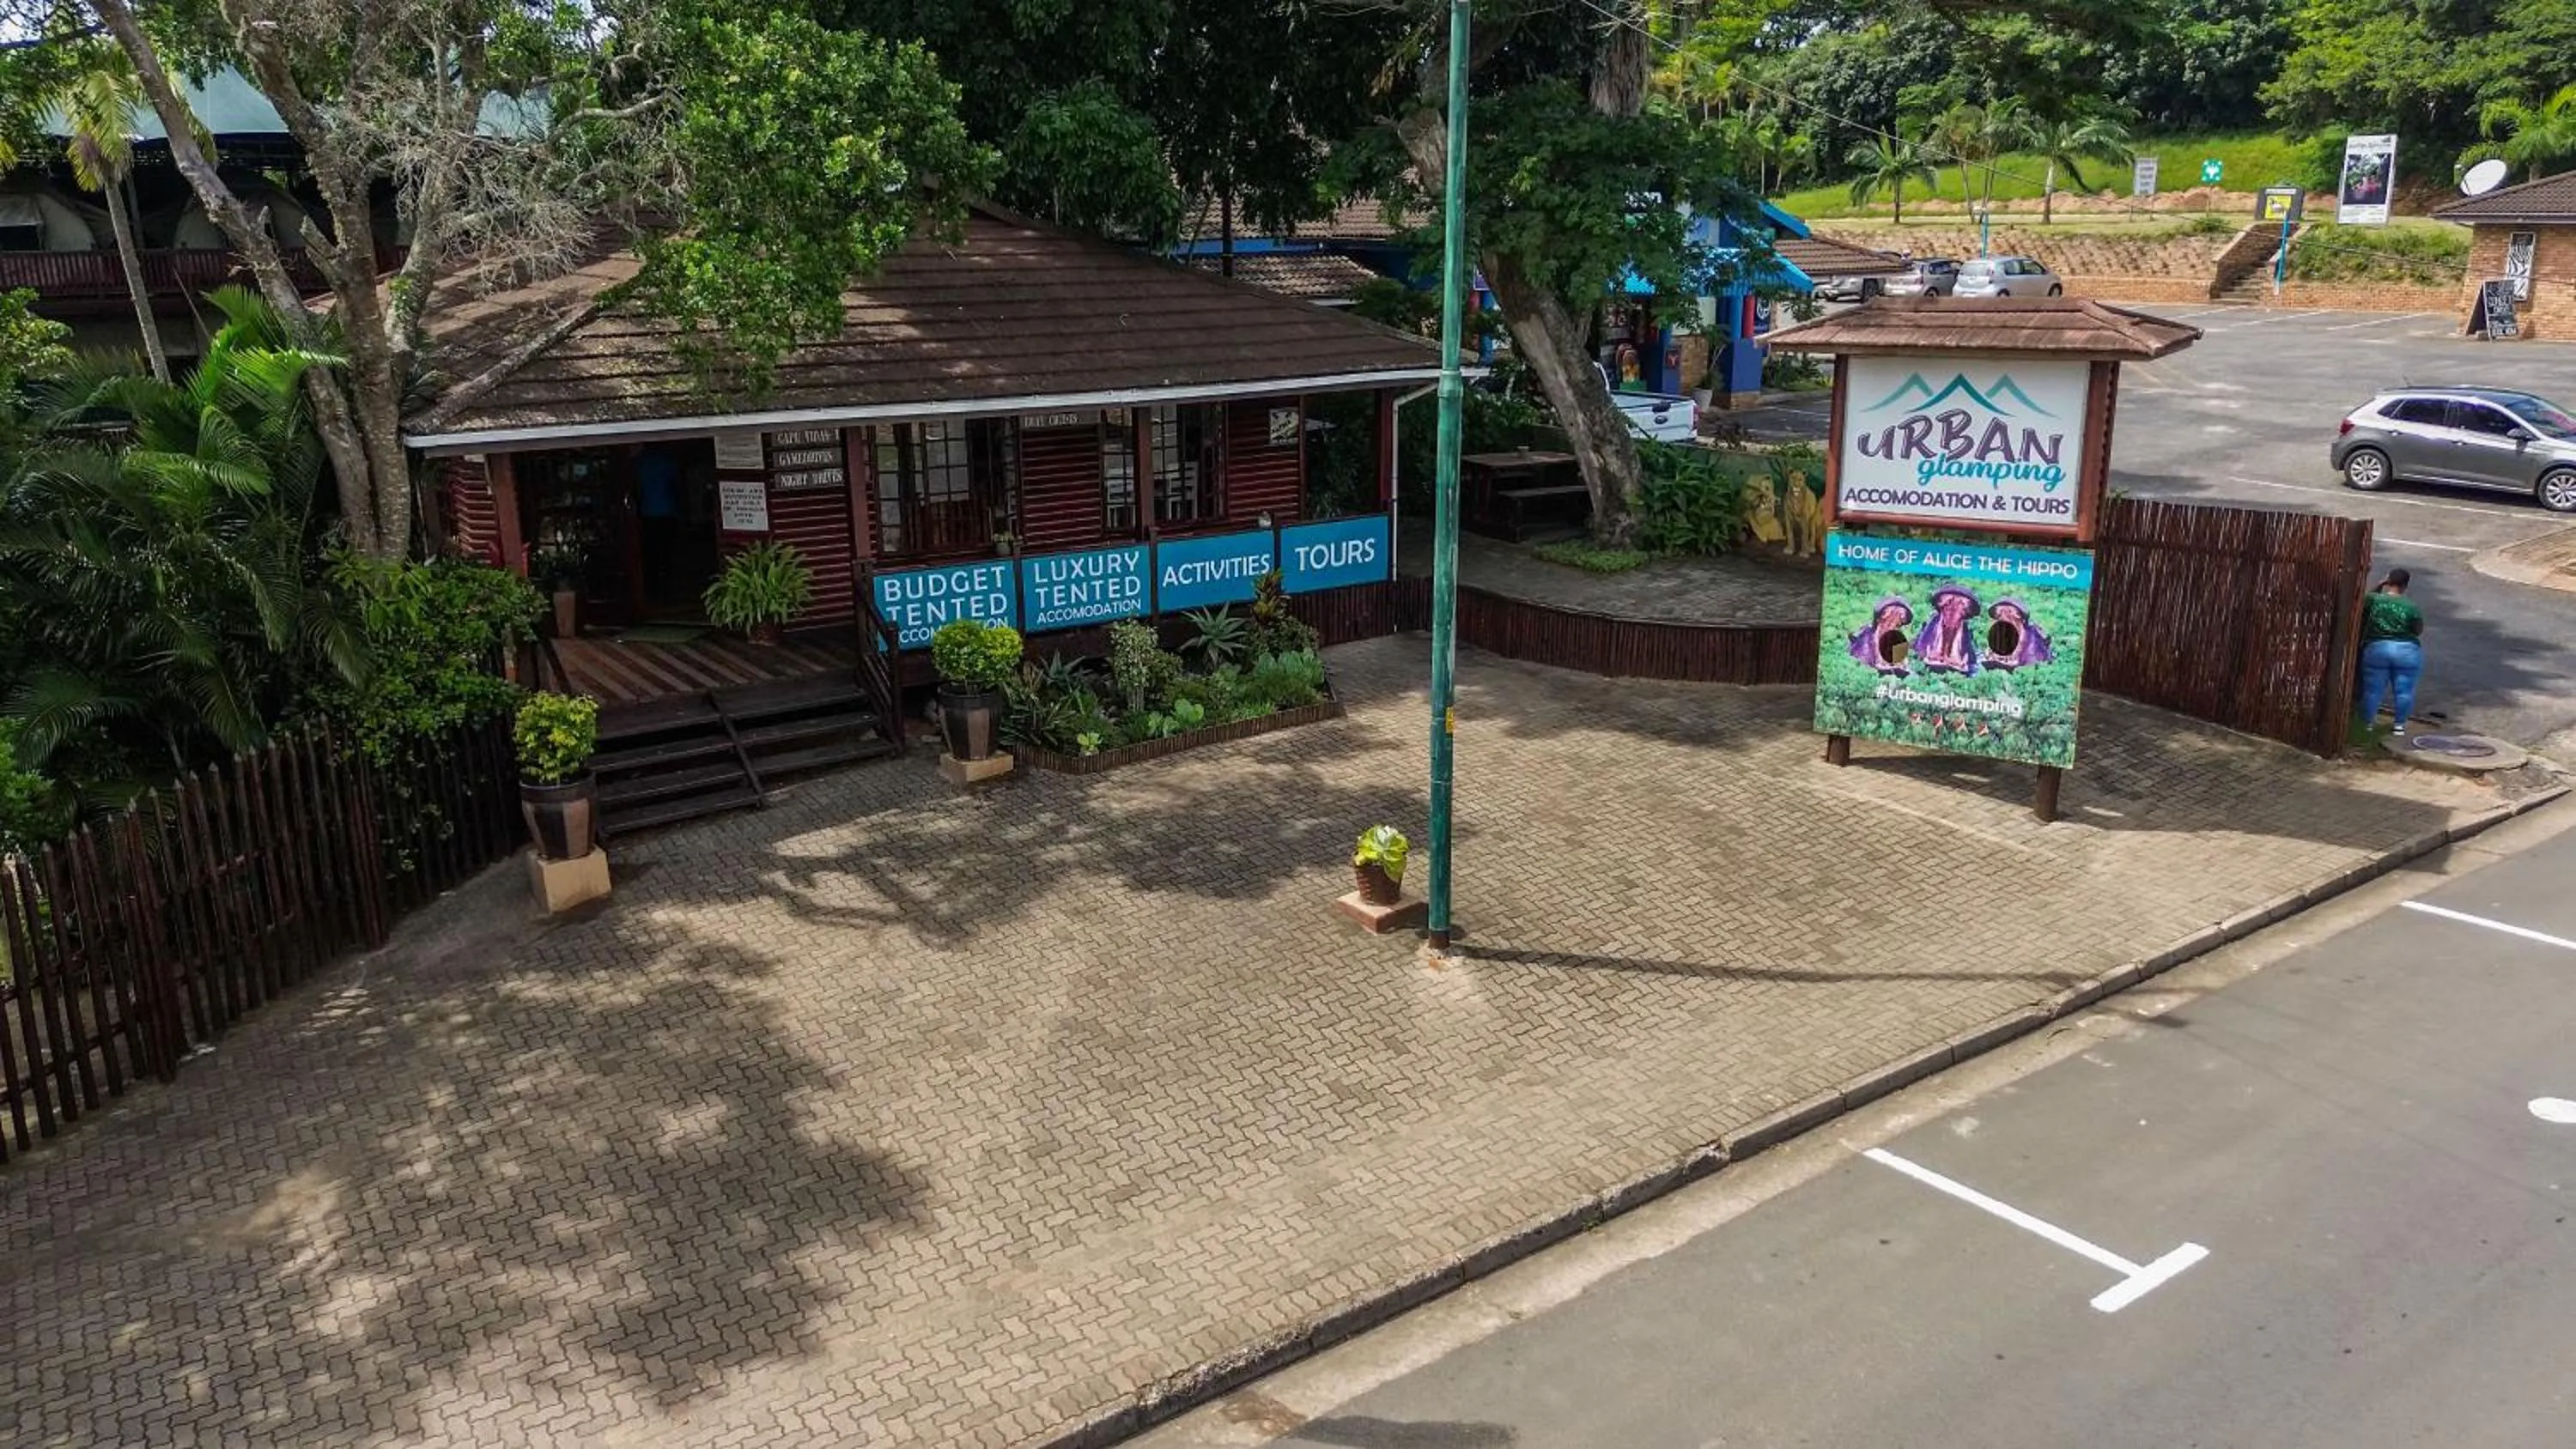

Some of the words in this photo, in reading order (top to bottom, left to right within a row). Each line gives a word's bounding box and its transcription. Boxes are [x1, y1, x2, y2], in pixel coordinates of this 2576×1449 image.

[1917, 452, 2066, 493] glamping
[1844, 487, 1988, 509] ACCOMODATION
[1992, 495, 2007, 511] &
[2011, 496, 2070, 515] TOURS
[1035, 550, 1139, 583] LUXURY
[1162, 554, 1271, 587] ACTIVITIES
[1295, 538, 1375, 572] TOURS
[1838, 544, 1889, 562] HOME
[1894, 549, 1919, 564] OF
[1923, 551, 1972, 570] ALICE
[1978, 555, 2013, 573] THE
[2017, 560, 2077, 579] HIPPO
[884, 566, 1005, 603] BUDGET
[1035, 576, 1140, 609] TENTED
[886, 593, 1008, 627] TENTED
[1036, 599, 1141, 624] ACCOMODATION
[1876, 686, 2022, 718] #urbanglamping
